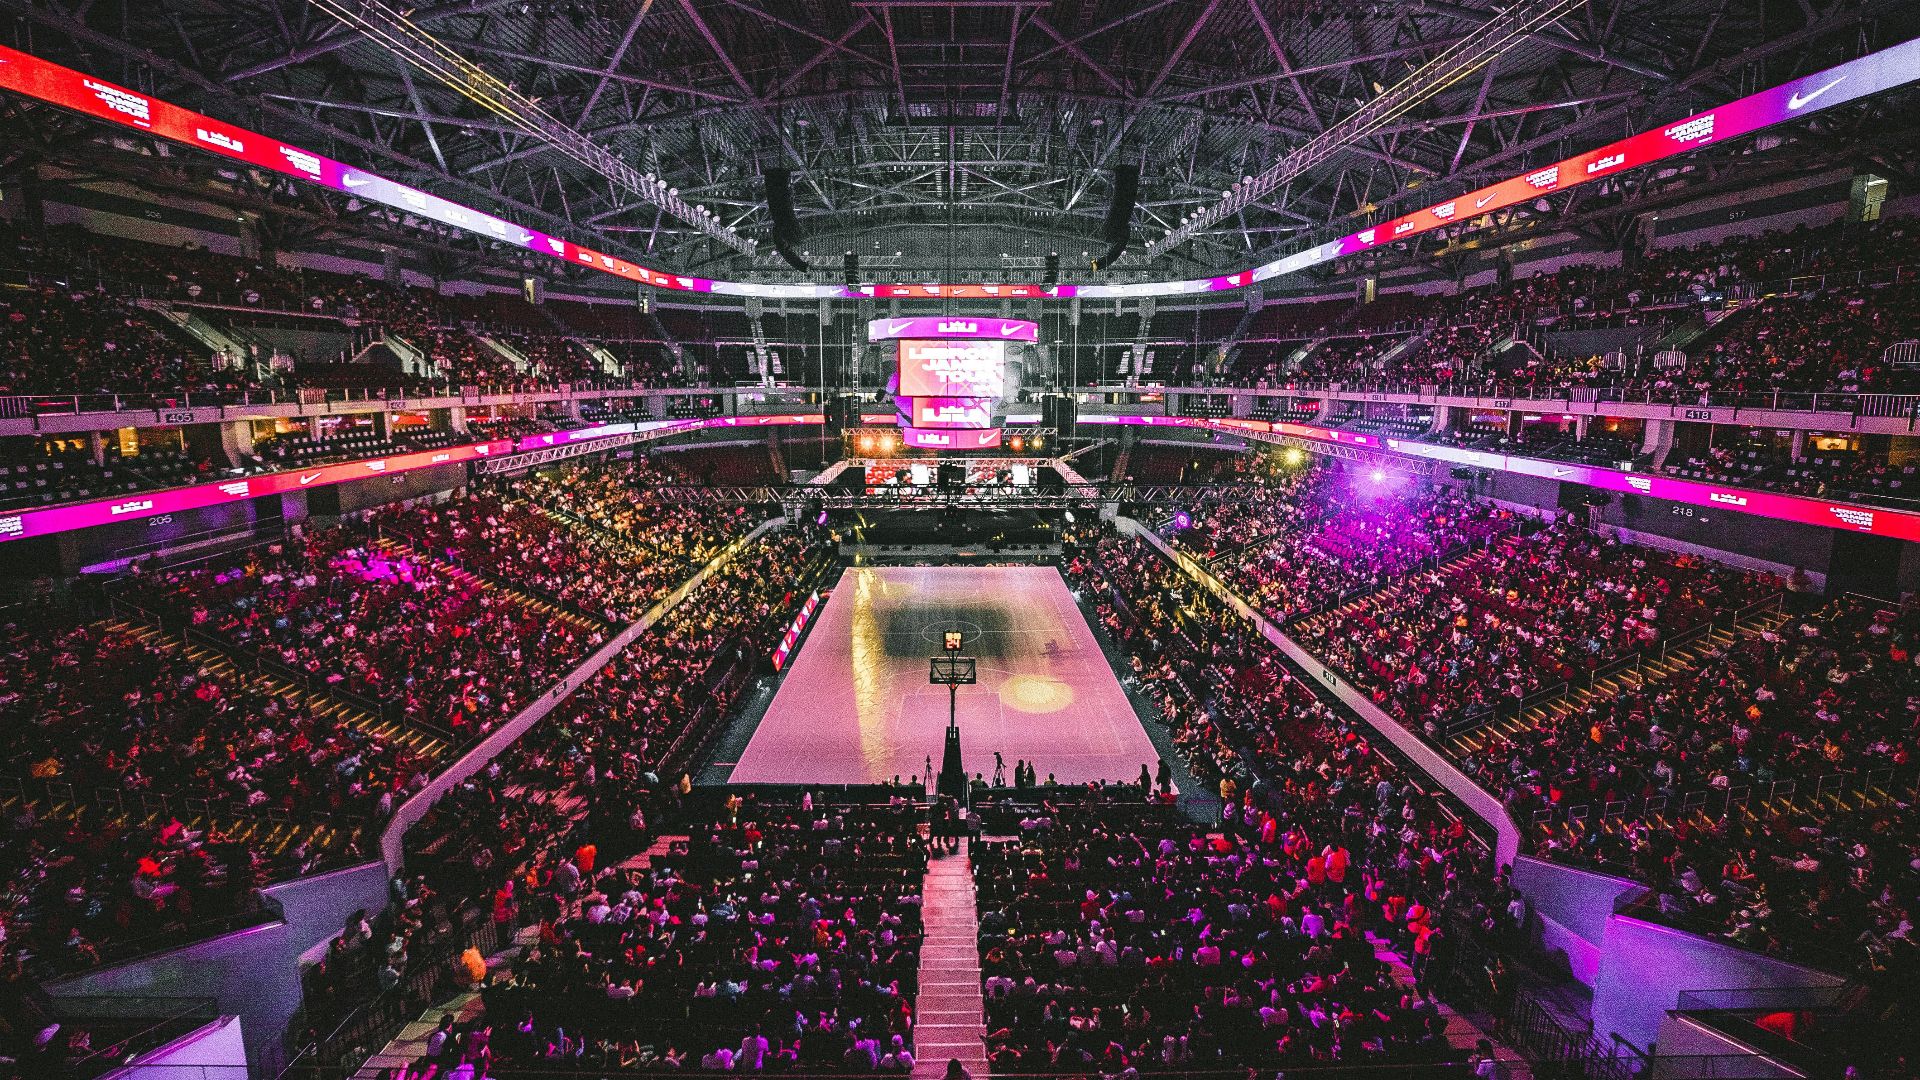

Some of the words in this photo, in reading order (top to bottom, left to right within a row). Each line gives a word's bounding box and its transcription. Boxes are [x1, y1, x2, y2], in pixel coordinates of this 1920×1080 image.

[1729, 210, 1746, 220] 517
[168, 413, 191, 422] 405
[1687, 411, 1709, 420] 418
[1672, 506, 1694, 516] 218
[1829, 507, 1874, 518] LEBRON
[148, 515, 172, 527] 205
[1835, 512, 1873, 522] JAMES
[1841, 517, 1873, 527] TOUR
[946, 639, 961, 649] 24
